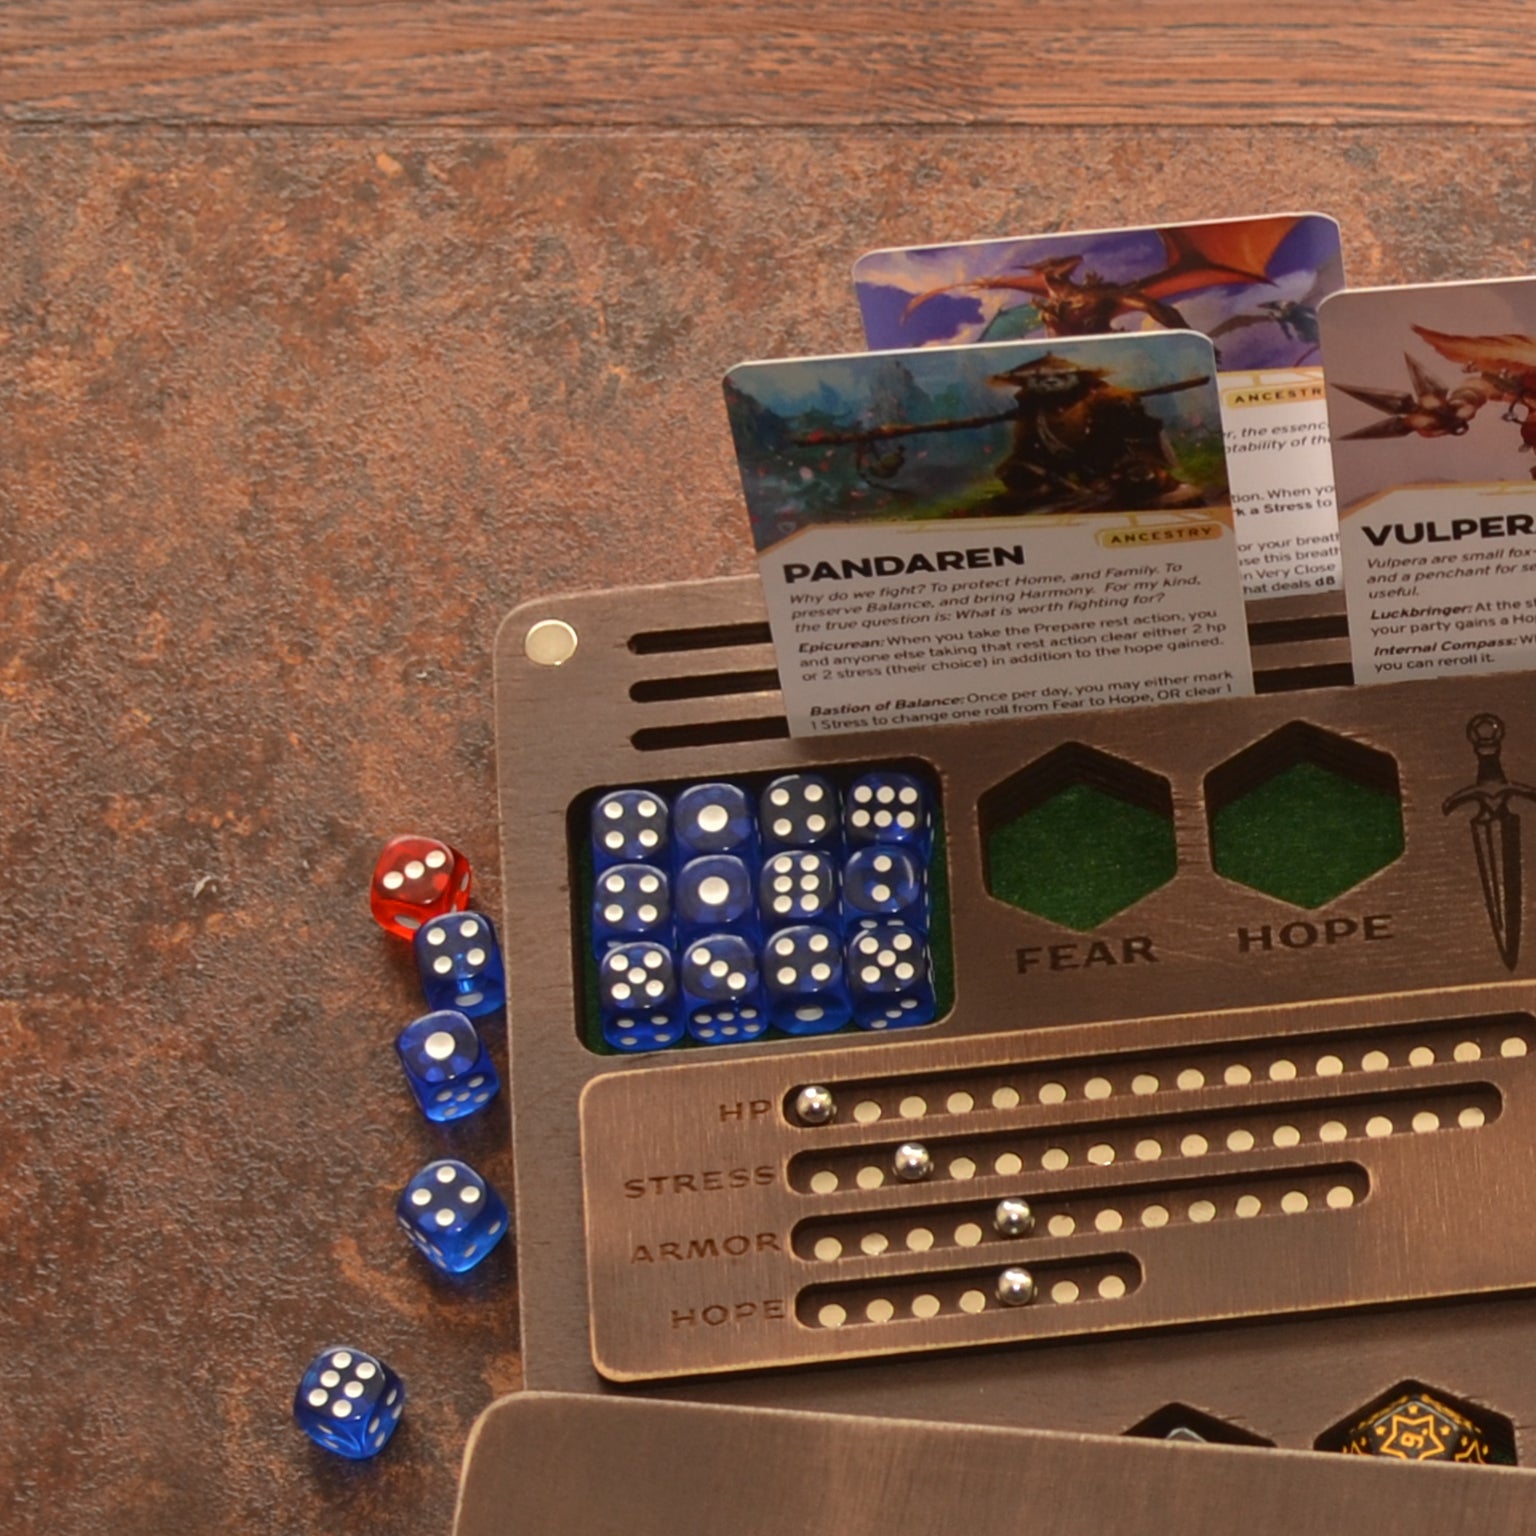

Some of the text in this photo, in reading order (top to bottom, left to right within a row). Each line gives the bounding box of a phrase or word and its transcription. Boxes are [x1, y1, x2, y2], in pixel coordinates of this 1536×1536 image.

[1234, 388, 1323, 404] ANCESTR
[1110, 527, 1213, 544] ANCESTRY
[783, 545, 1025, 584] PANDAREN
[1367, 556, 1428, 569] Vulpera
[1430, 554, 1458, 565] are
[1461, 548, 1505, 562] small
[789, 593, 825, 605] Why
[827, 591, 849, 602] do
[852, 590, 876, 600] we
[930, 582, 948, 593] To
[951, 577, 1011, 594] protect
[1070, 569, 1102, 582] and
[1165, 562, 1183, 573] To
[1474, 601, 1492, 613] At
[1495, 600, 1522, 611] the
[1370, 624, 1407, 638] your
[1409, 620, 1452, 635] party
[1454, 617, 1497, 632] gains
[1499, 616, 1510, 626] a
[1373, 662, 1403, 675] you
[1406, 659, 1435, 670] can
[1437, 654, 1478, 667] reroll
[1238, 913, 1393, 953] HOPE
[1014, 936, 1157, 975] FEAR
[719, 1097, 772, 1125] HP
[623, 1165, 775, 1198] STRESS
[630, 1231, 781, 1264] ARMOR
[671, 1297, 785, 1329] HOPE
